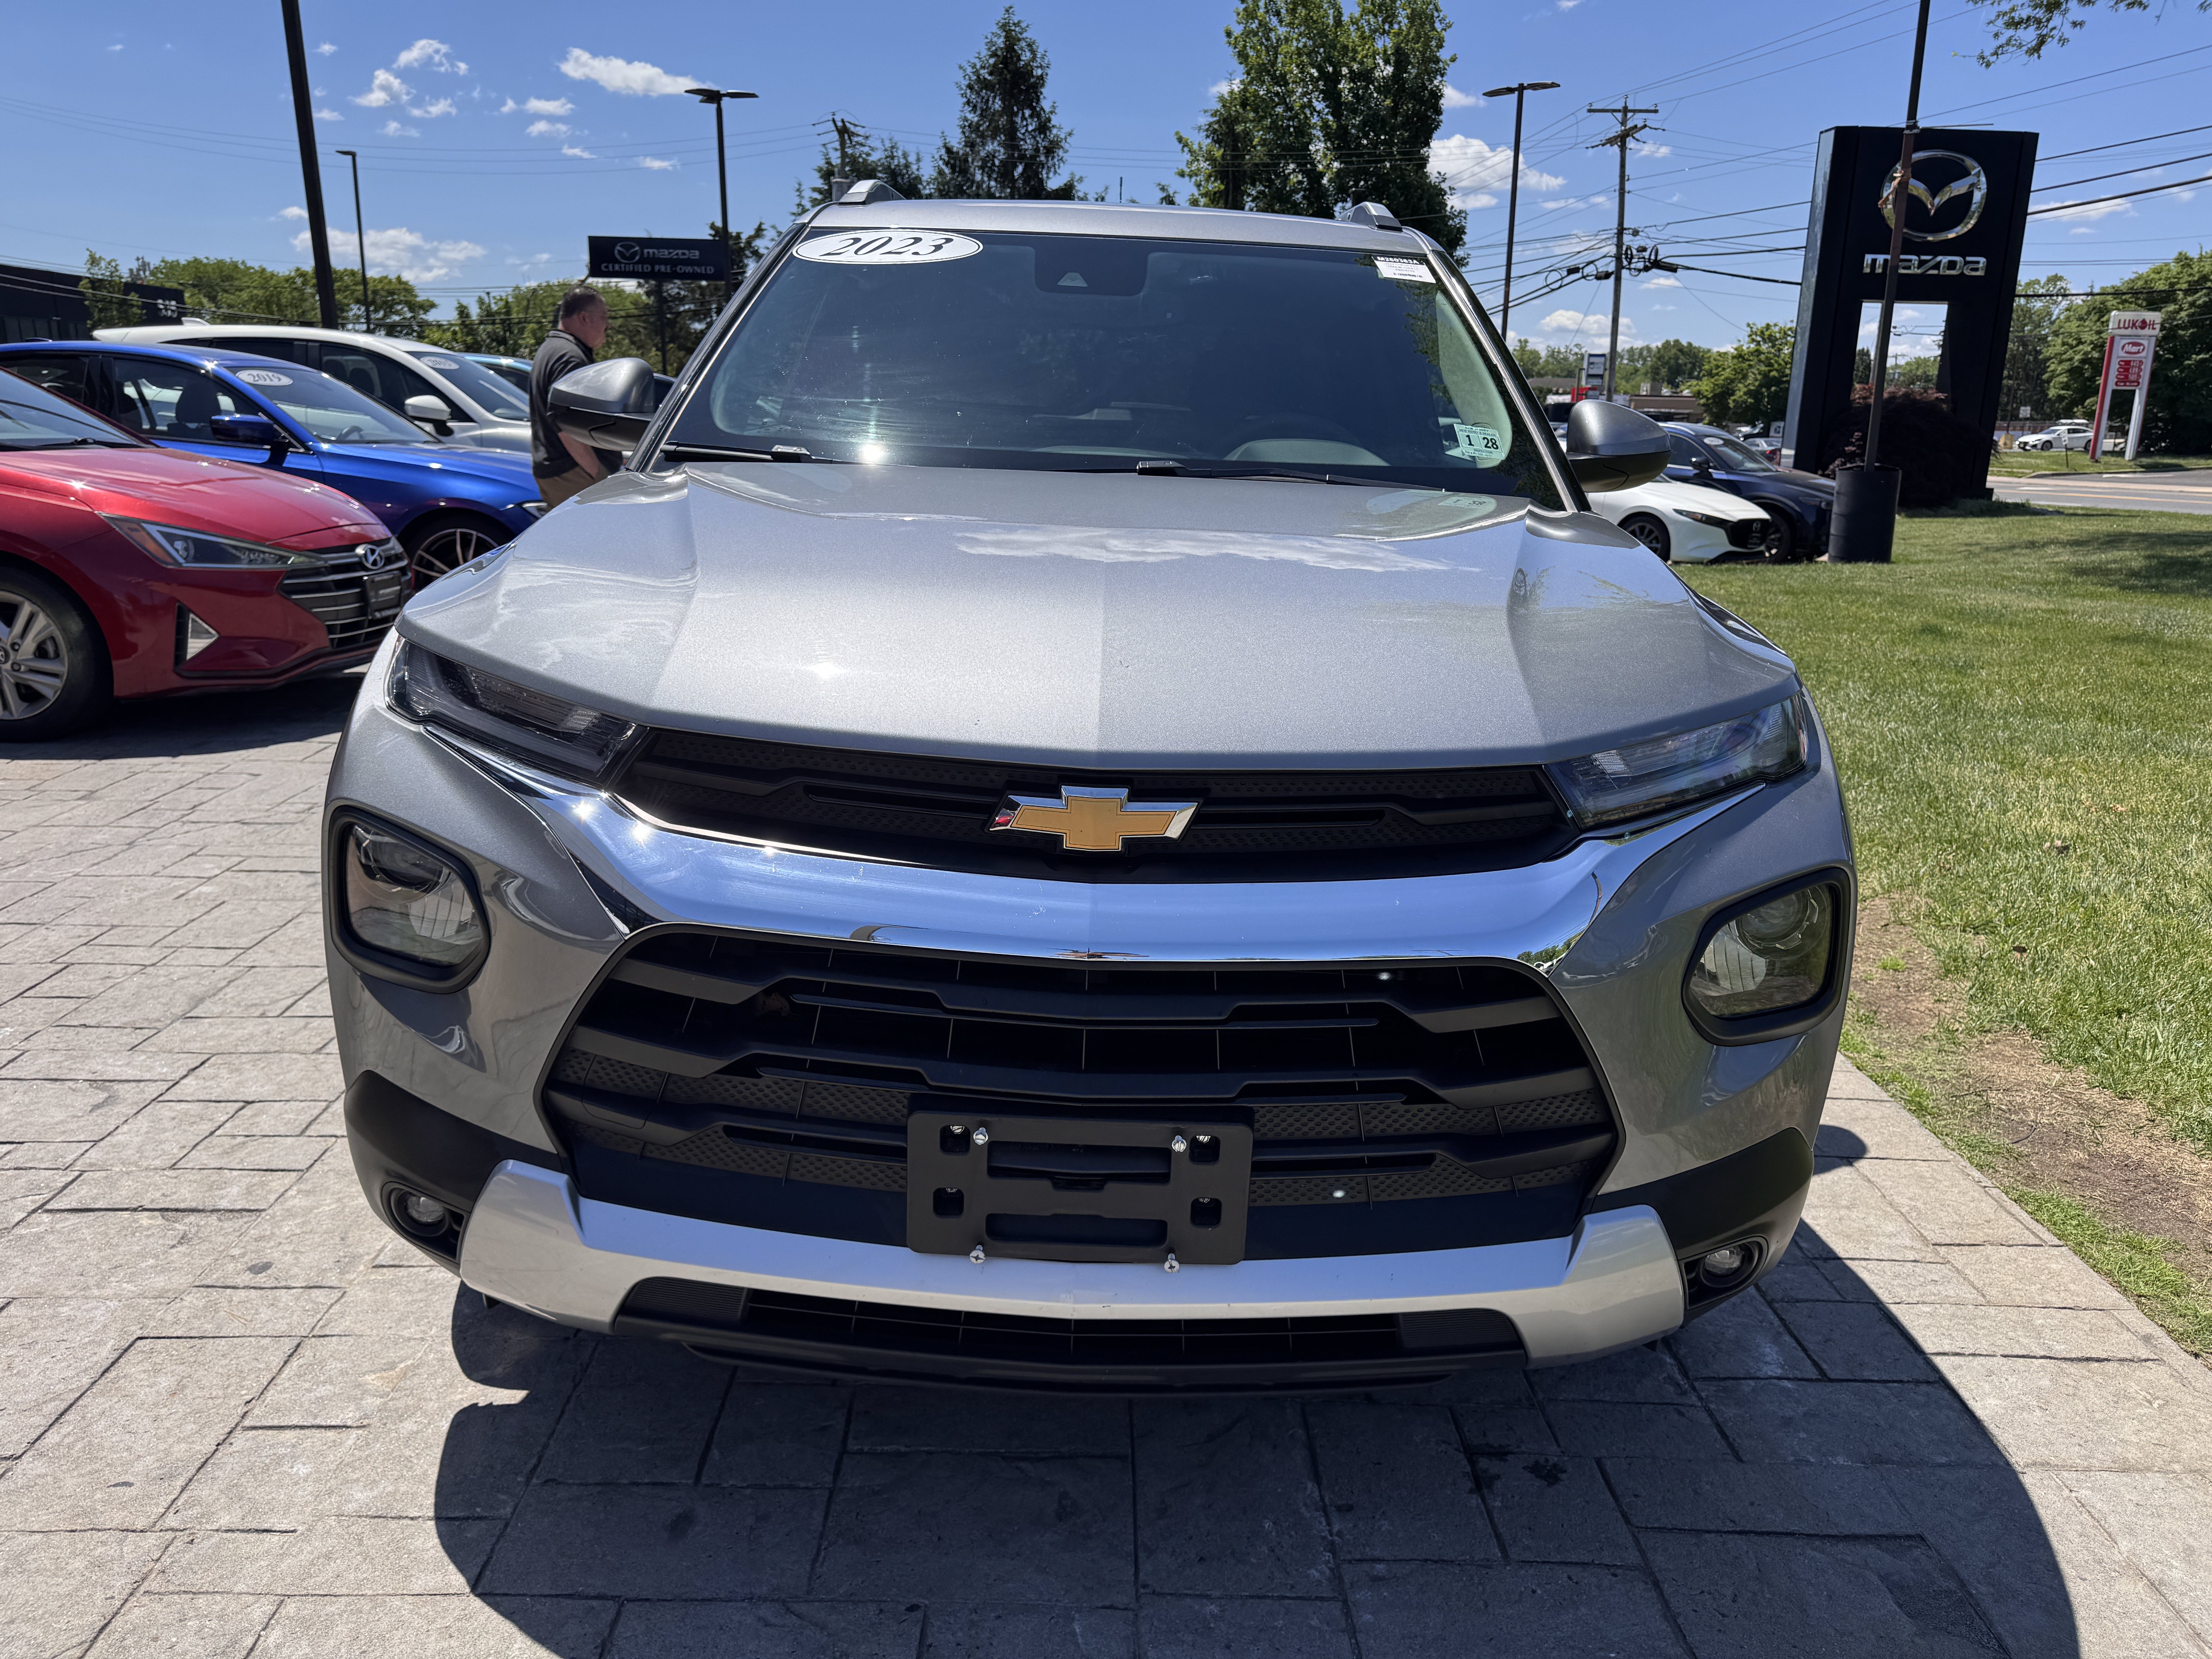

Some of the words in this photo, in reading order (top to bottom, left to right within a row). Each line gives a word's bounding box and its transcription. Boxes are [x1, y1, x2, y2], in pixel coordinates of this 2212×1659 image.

[819, 236, 954, 256] 2023
[601, 263, 651, 272] CERTIFIED
[654, 264, 714, 274] PRE-OWNED
[247, 373, 282, 382] 2019
[1466, 434, 1474, 447] 1
[1482, 437, 1499, 450] 28
